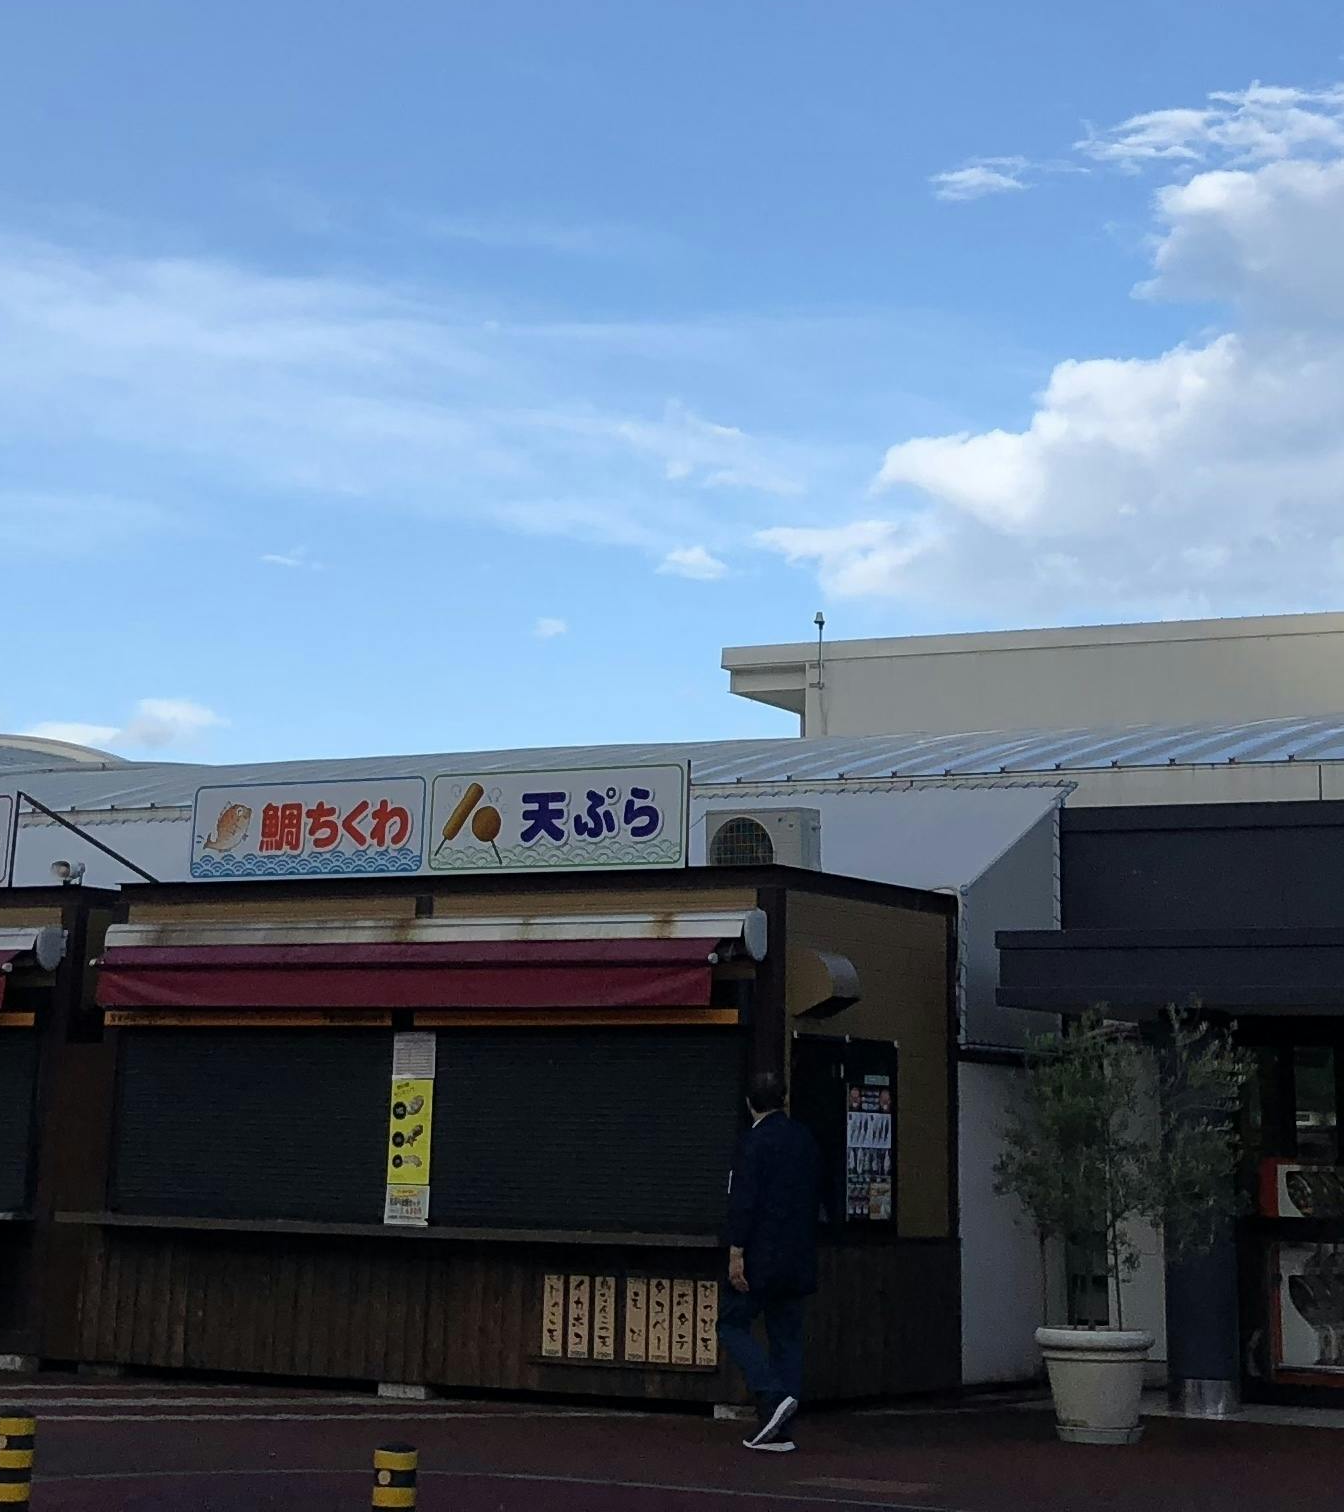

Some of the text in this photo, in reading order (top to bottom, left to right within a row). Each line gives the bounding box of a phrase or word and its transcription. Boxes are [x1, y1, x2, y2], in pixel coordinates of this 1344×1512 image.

[258, 799, 414, 853] 鯛ちくわ
[520, 787, 665, 844] 天ぷら
